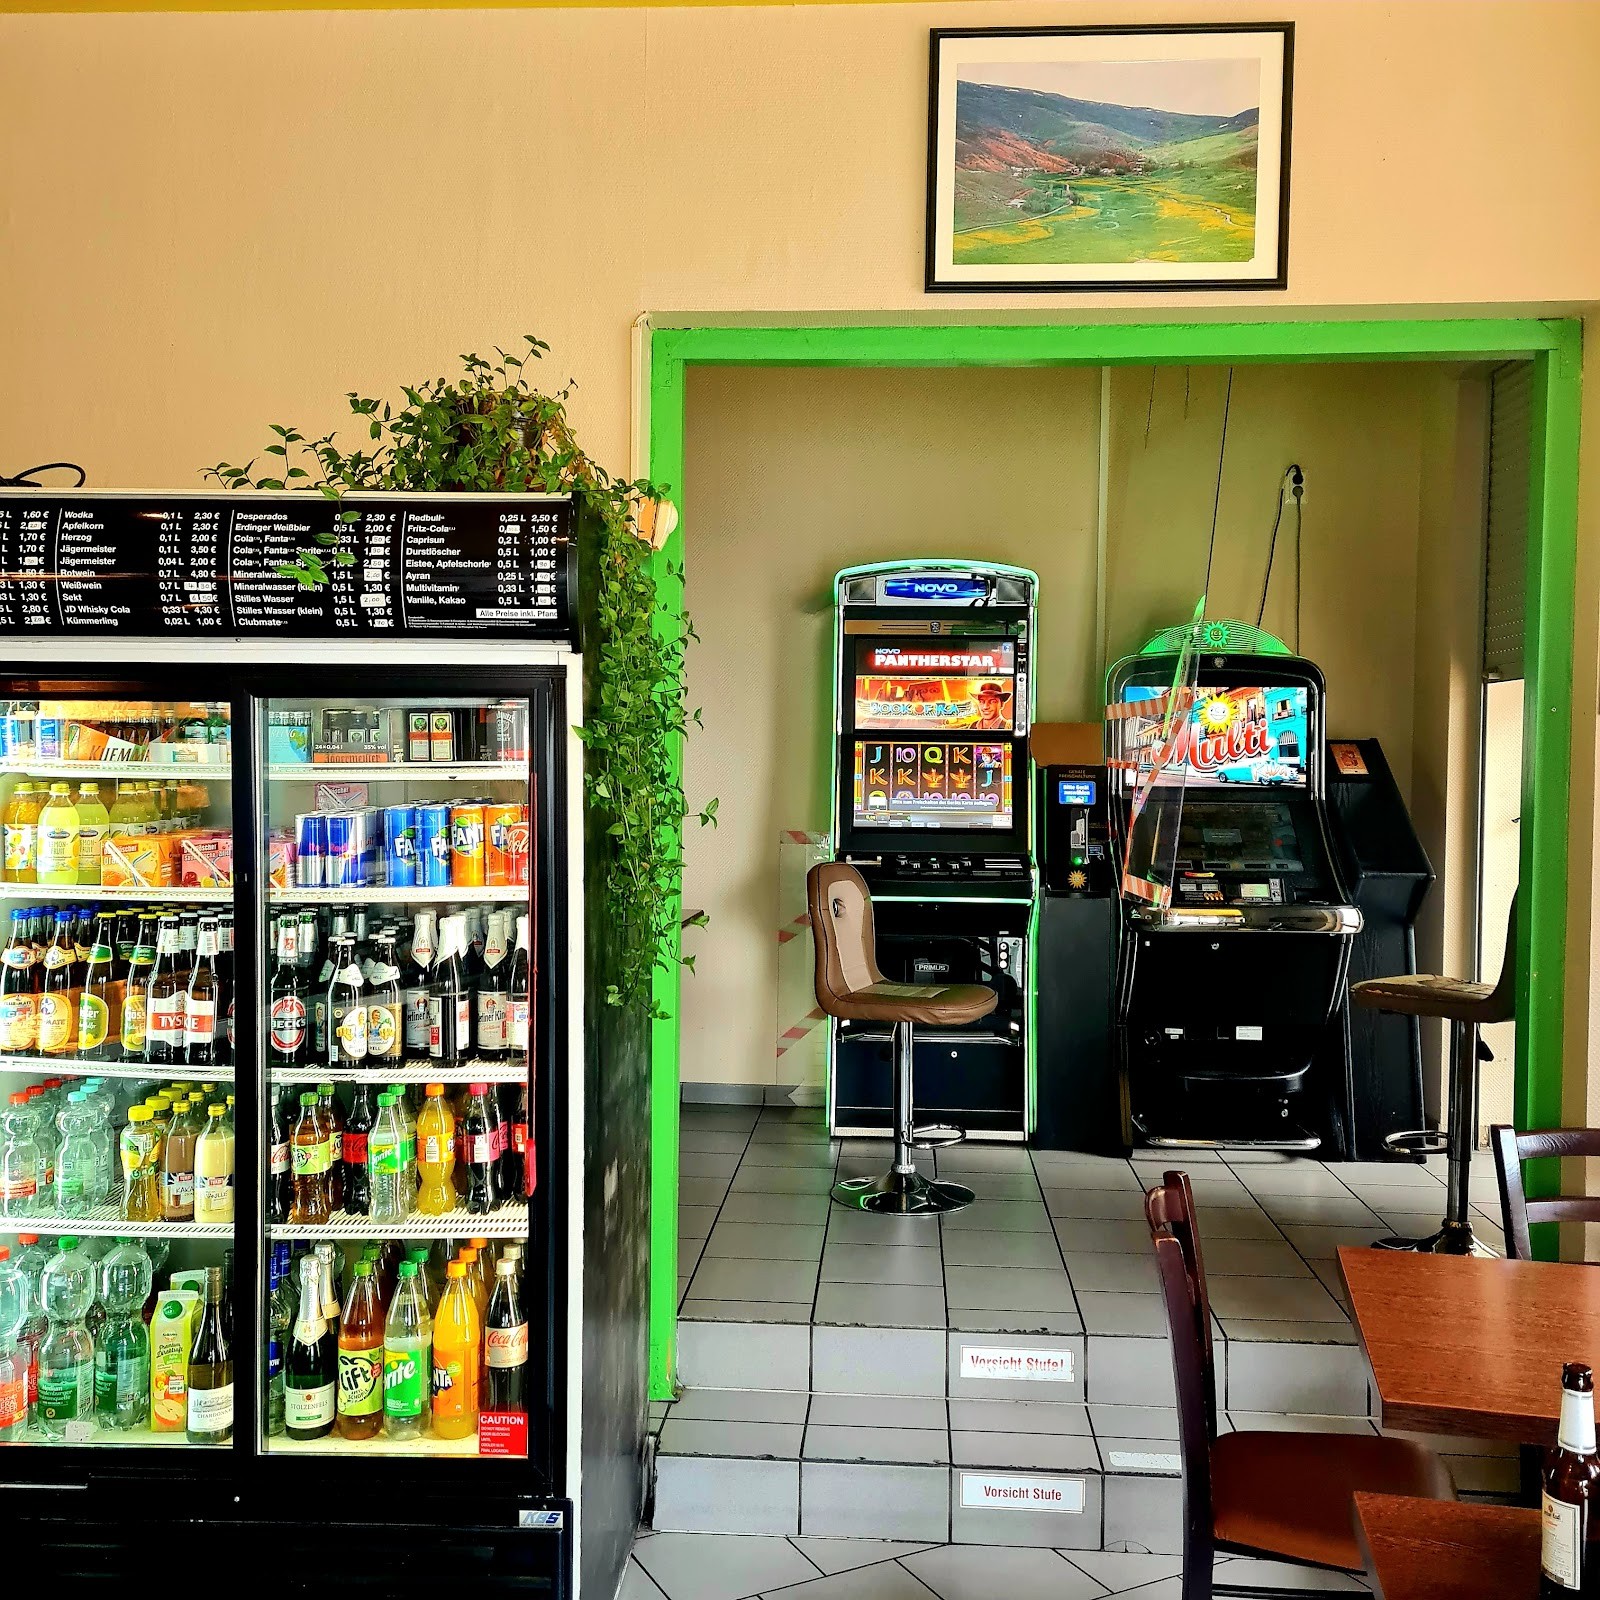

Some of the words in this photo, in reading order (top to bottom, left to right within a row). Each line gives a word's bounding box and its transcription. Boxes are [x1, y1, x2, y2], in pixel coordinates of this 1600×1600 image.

[23, 511, 41, 519] 1,60
[161, 512, 174, 520] 0,1
[194, 512, 212, 520] 2,30
[237, 513, 288, 521] Desperados
[366, 514, 385, 522] 2,30
[500, 514, 518, 523] 0,25
[531, 514, 550, 523] 2,50
[62, 522, 104, 530] Apfelkorn
[161, 523, 173, 531] 0,1
[193, 523, 211, 531] 2,30
[235, 524, 272, 532] Erdinger
[365, 525, 384, 533] 2,00
[531, 525, 549, 535] 1,50
[19, 533, 37, 542] 1,70
[61, 533, 92, 542] Herzog
[160, 534, 172, 542] 0,1
[191, 534, 209, 542] 2,00
[407, 536, 444, 545] Caprisun
[498, 536, 512, 545] 0,2
[530, 537, 549, 545] 1,00
[19, 545, 37, 553] 1,70
[60, 545, 116, 554] Jägermeister
[159, 546, 171, 554] 0,1
[191, 546, 209, 554] 3,50
[498, 548, 511, 557] 0,5
[530, 548, 548, 557] 1,00
[60, 557, 116, 566] Jägermeister
[158, 557, 176, 566] 0,04
[190, 558, 208, 566] 2,00
[406, 559, 434, 569] Eistee,
[497, 560, 511, 569] 0,5
[60, 569, 95, 577] Rotwein
[159, 570, 171, 578] 0,7
[191, 570, 208, 579] 4,80
[332, 571, 345, 580] 1,5
[405, 572, 430, 581] Ayran
[498, 572, 516, 581] 0,25
[19, 581, 38, 590] 1,30
[60, 581, 102, 589] Weißwein
[159, 582, 172, 590] 0,7
[332, 583, 346, 592] 0,5
[364, 584, 382, 592] 1,30
[498, 584, 516, 594] 0,33
[915, 583, 958, 593] NOVO
[21, 593, 39, 602] 1,30
[62, 593, 82, 601] Sekt
[161, 594, 173, 603] 0,7
[333, 596, 347, 604] 1,5
[407, 596, 437, 605] Vanille,
[439, 596, 466, 604] Kakao
[498, 597, 512, 606] 0,5
[22, 605, 41, 614] 2,80
[64, 605, 76, 613] JD
[78, 606, 108, 614] Whisky
[162, 606, 181, 614] 0,33
[192, 605, 212, 614] 4,30
[297, 607, 323, 616] (klein)
[334, 607, 348, 616] 0,5
[366, 608, 385, 616] 1,30
[67, 617, 118, 626] Kümmerling
[164, 618, 183, 626] 0,02
[197, 618, 214, 626] 1,00
[336, 619, 350, 627] 0,5
[875, 655, 994, 667] PANTHERSTAR
[1152, 717, 1270, 773] Multi
[870, 746, 882, 764] J
[924, 747, 943, 763] Q
[953, 747, 971, 764] K
[870, 768, 888, 785] K
[897, 768, 916, 786] K
[970, 1355, 1022, 1370] Vorsicht
[1026, 1357, 1064, 1372] Stufe!
[480, 1415, 524, 1425] CAUTION
[984, 1485, 1029, 1499] Vorsicht
[1033, 1487, 1062, 1501] Stufe
[522, 1511, 561, 1524] KBS
